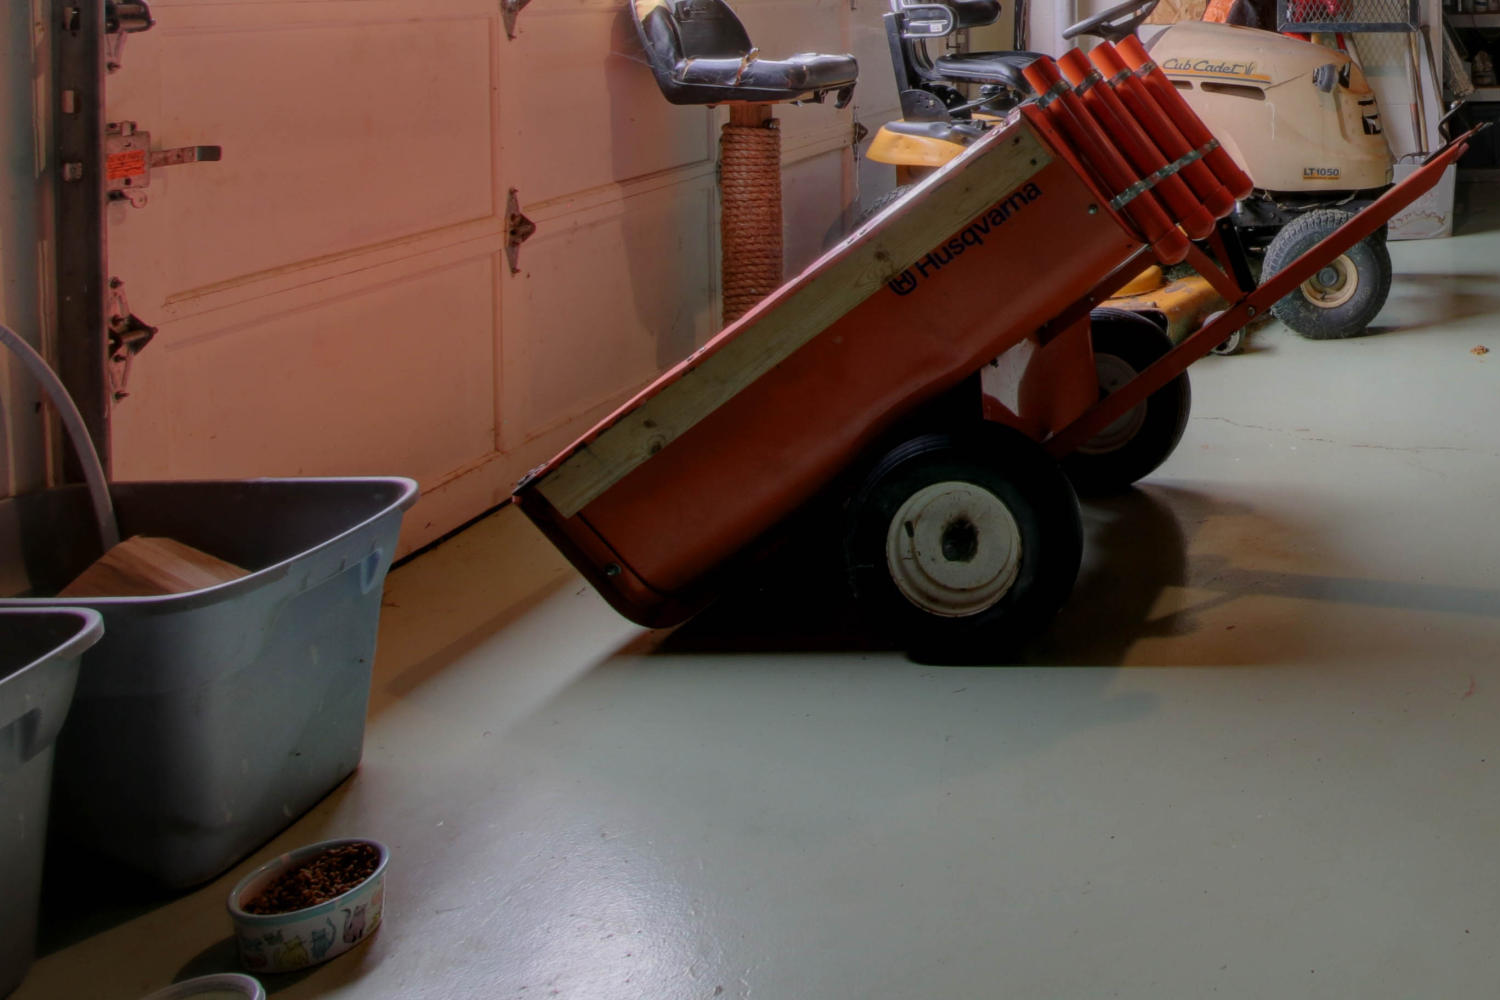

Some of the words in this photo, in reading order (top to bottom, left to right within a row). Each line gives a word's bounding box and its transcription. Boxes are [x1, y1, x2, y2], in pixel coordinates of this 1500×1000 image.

[1162, 58, 1192, 71] Cub
[1193, 60, 1244, 75] Cadet
[914, 182, 1042, 279] Husqvarna
